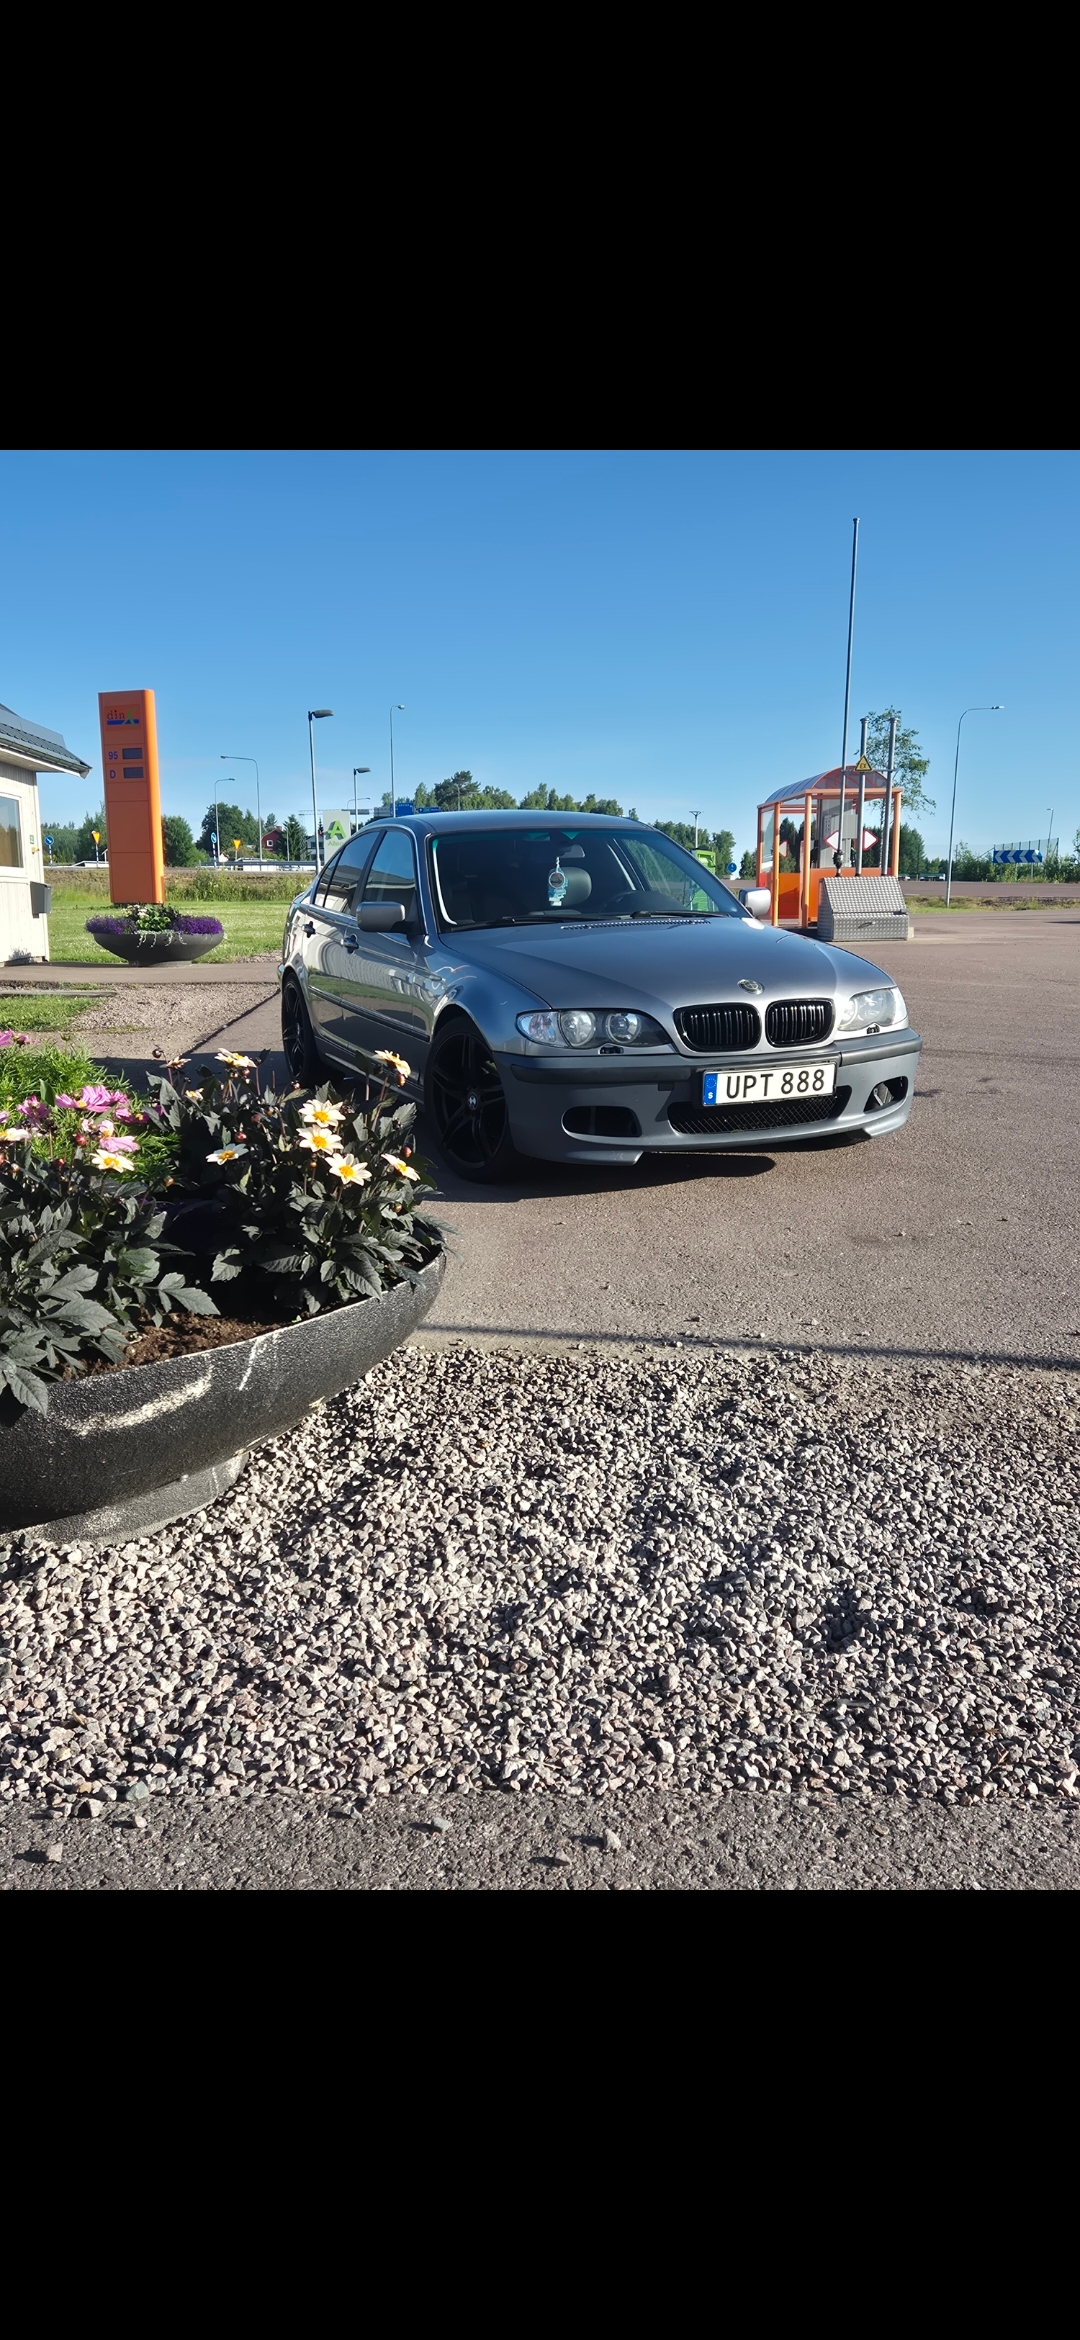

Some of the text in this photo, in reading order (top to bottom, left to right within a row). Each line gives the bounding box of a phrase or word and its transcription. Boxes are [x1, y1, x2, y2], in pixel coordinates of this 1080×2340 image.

[108, 751, 119, 760] 95
[109, 769, 116, 779] D
[726, 1069, 825, 1099] UPT 888
[707, 1091, 714, 1100] S
